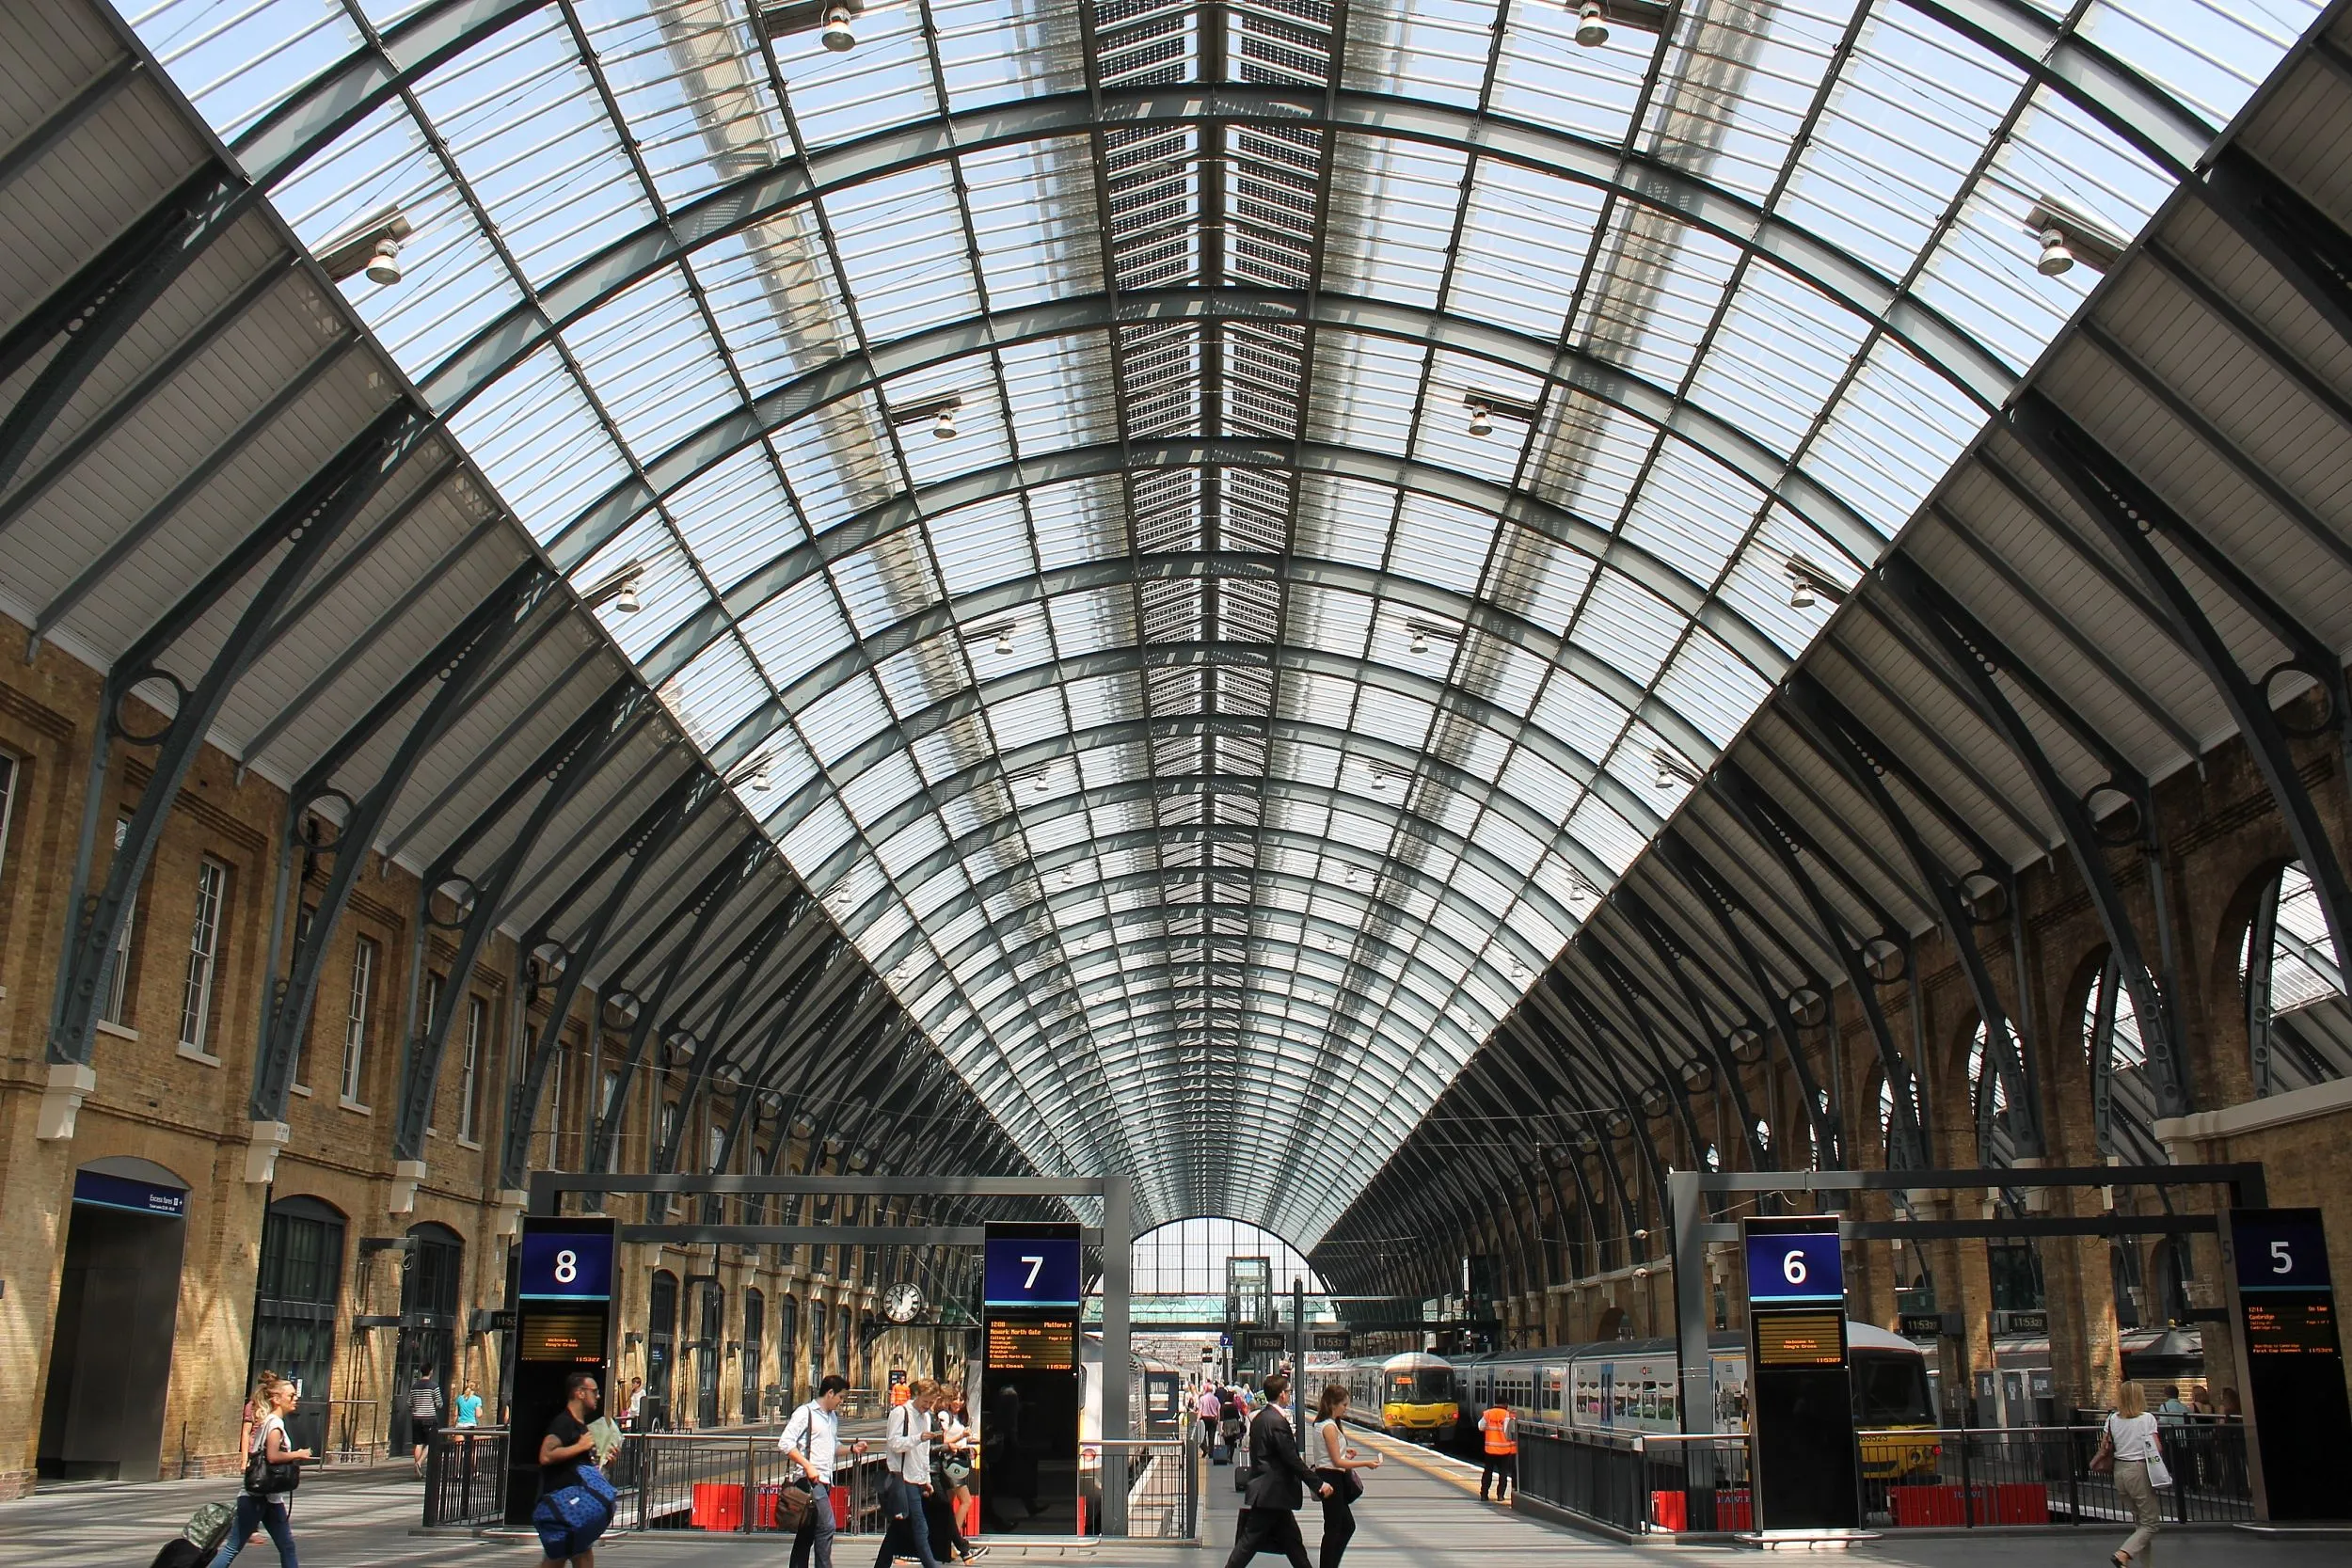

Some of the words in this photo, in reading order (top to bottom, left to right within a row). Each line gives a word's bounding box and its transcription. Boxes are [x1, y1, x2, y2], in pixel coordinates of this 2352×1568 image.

[555, 1250, 577, 1283] 8
[1020, 1256, 1044, 1289] 7
[1782, 1250, 1807, 1285] 6
[2271, 1241, 2293, 1274] 5
